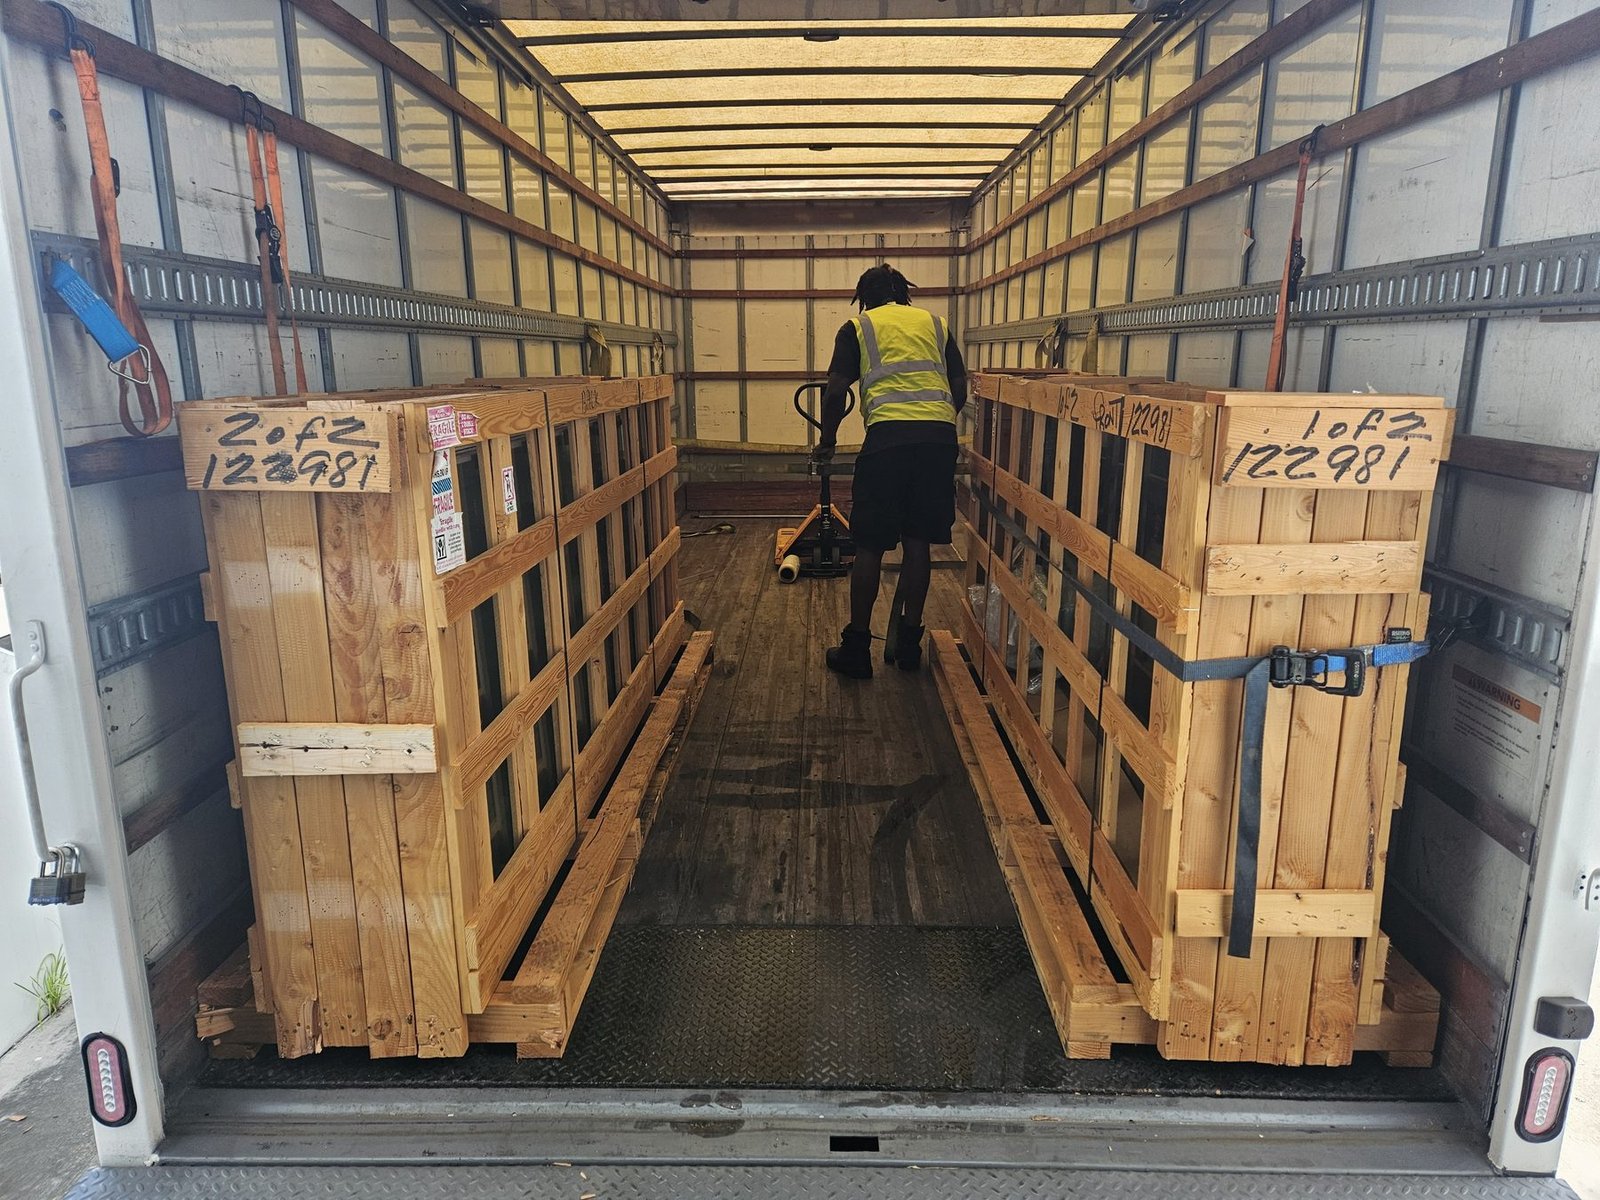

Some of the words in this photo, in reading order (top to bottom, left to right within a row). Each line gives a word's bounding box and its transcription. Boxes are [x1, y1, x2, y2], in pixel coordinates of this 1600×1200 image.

[1125, 401, 1174, 449] 122981
[202, 450, 378, 490] 122981
[1221, 442, 1411, 484] 122981
[1474, 677, 1521, 711] WARNING
